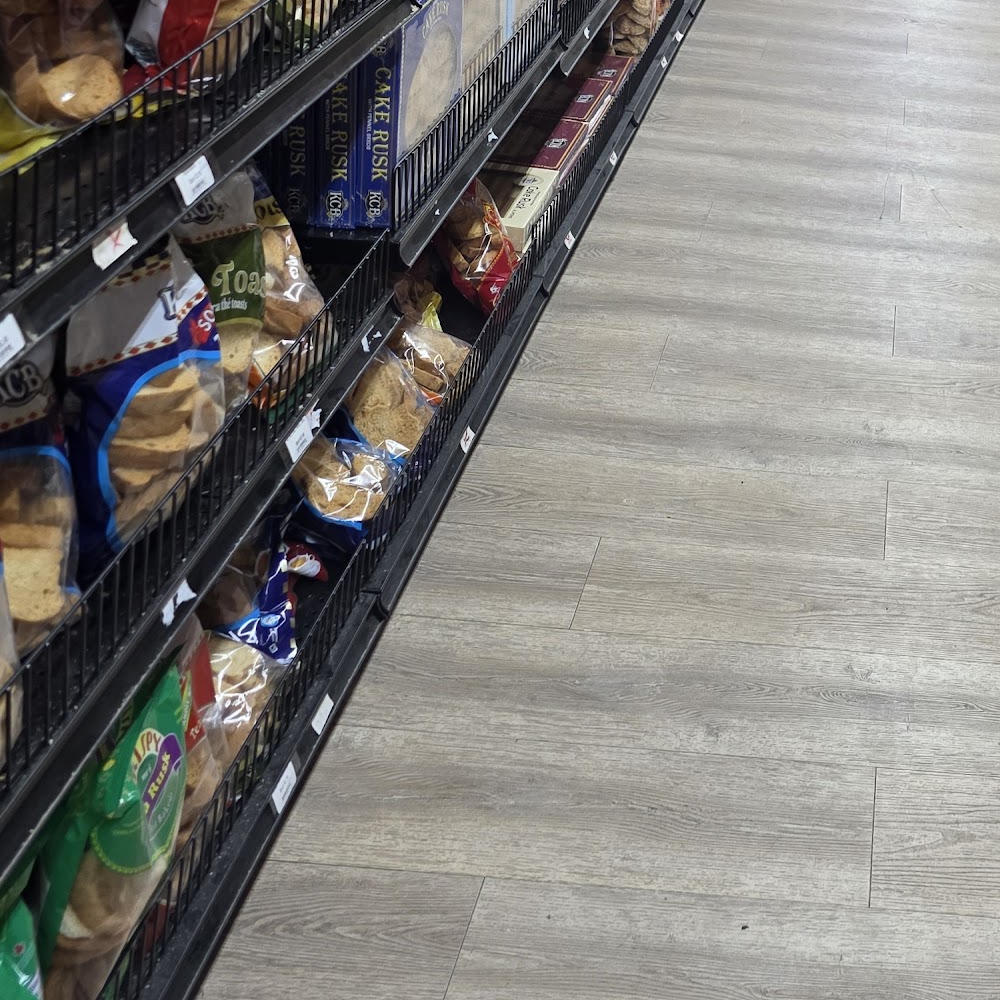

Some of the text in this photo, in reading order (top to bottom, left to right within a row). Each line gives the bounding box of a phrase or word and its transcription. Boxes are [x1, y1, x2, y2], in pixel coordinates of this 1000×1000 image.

[289, 126, 306, 177] RUSK
[328, 81, 348, 217] AKE RUSK KCB
[368, 67, 391, 217] CAKE RUSK KCB
[211, 259, 267, 298] Toas
[198, 308, 216, 332] SO
[0, 363, 44, 402] CB
[148, 751, 172, 800] Rusk
